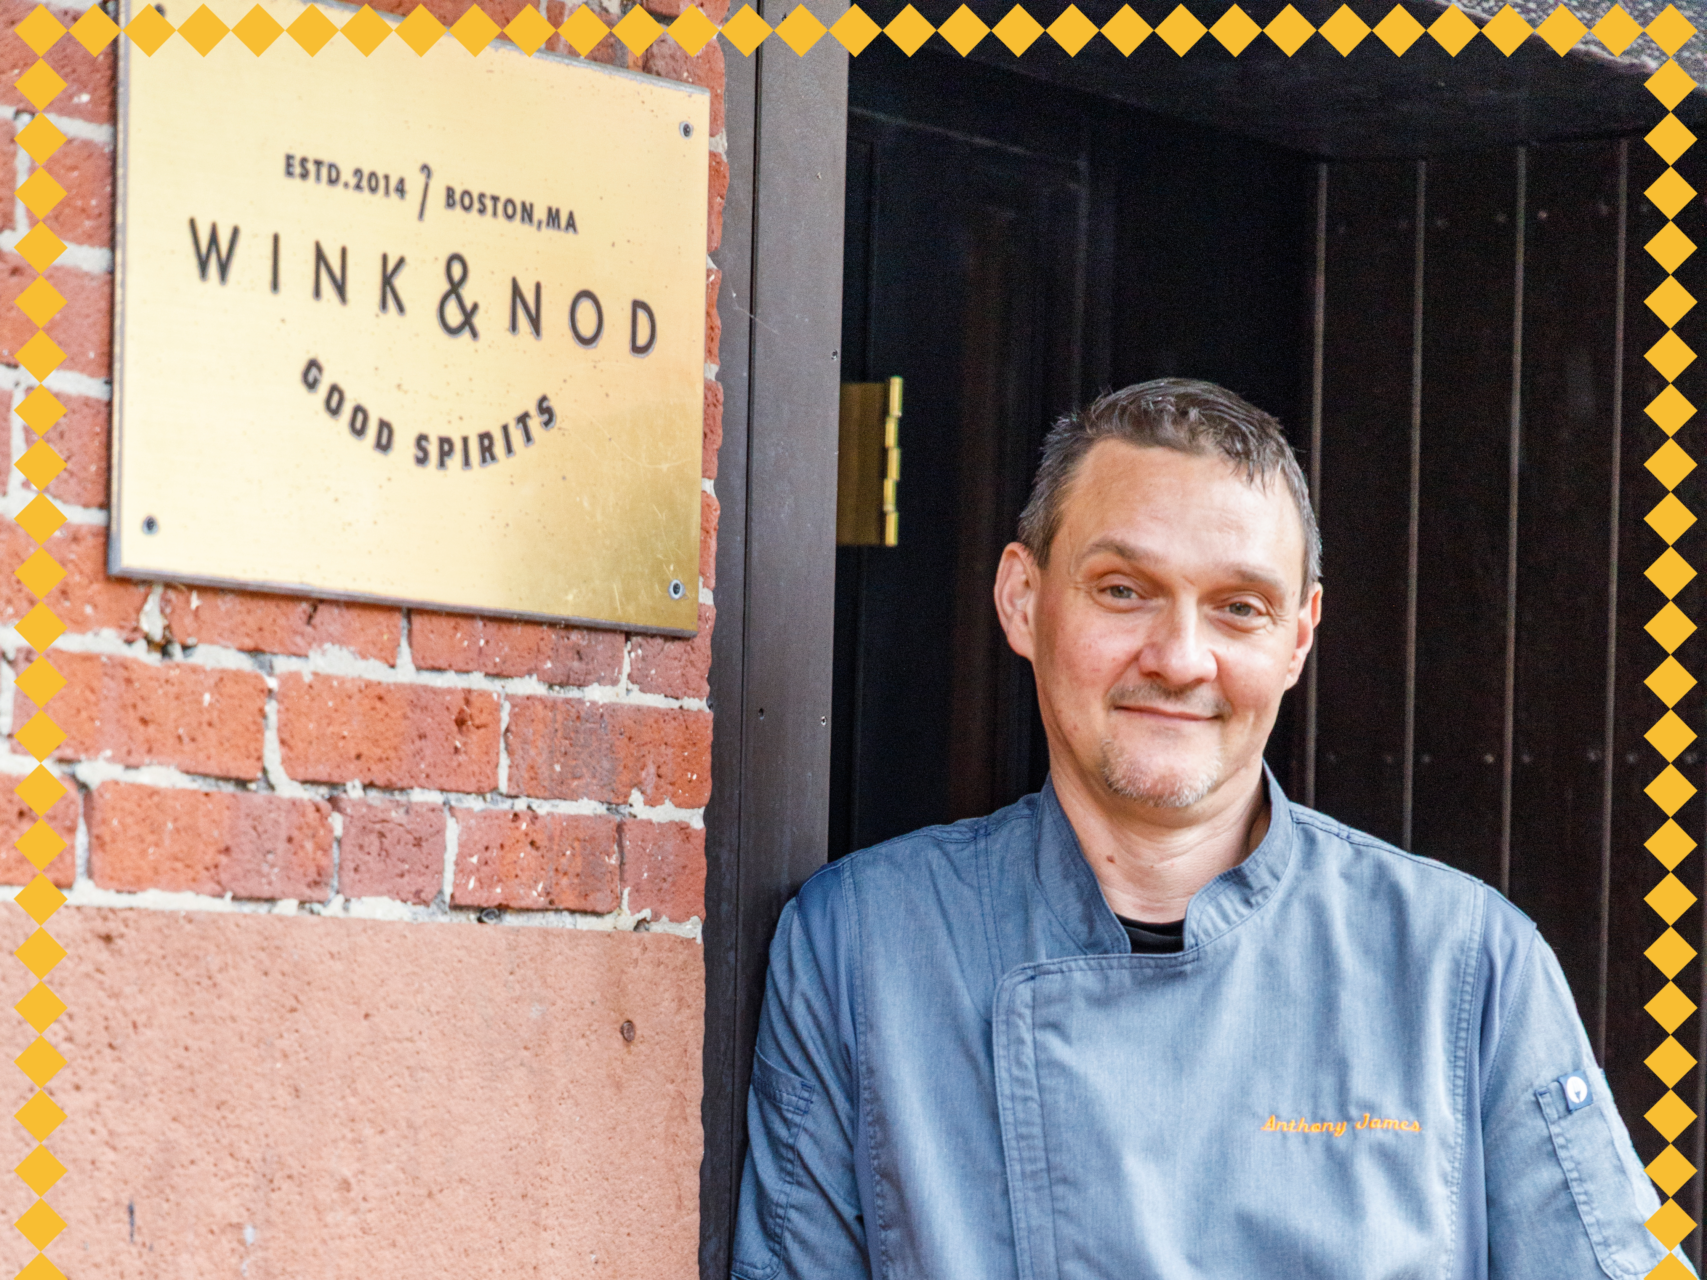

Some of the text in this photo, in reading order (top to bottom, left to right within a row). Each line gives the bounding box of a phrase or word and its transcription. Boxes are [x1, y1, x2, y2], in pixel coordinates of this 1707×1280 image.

[302, 358, 557, 471] GOOD SPIRITS
[1261, 1113, 1422, 1137] Anthony James
